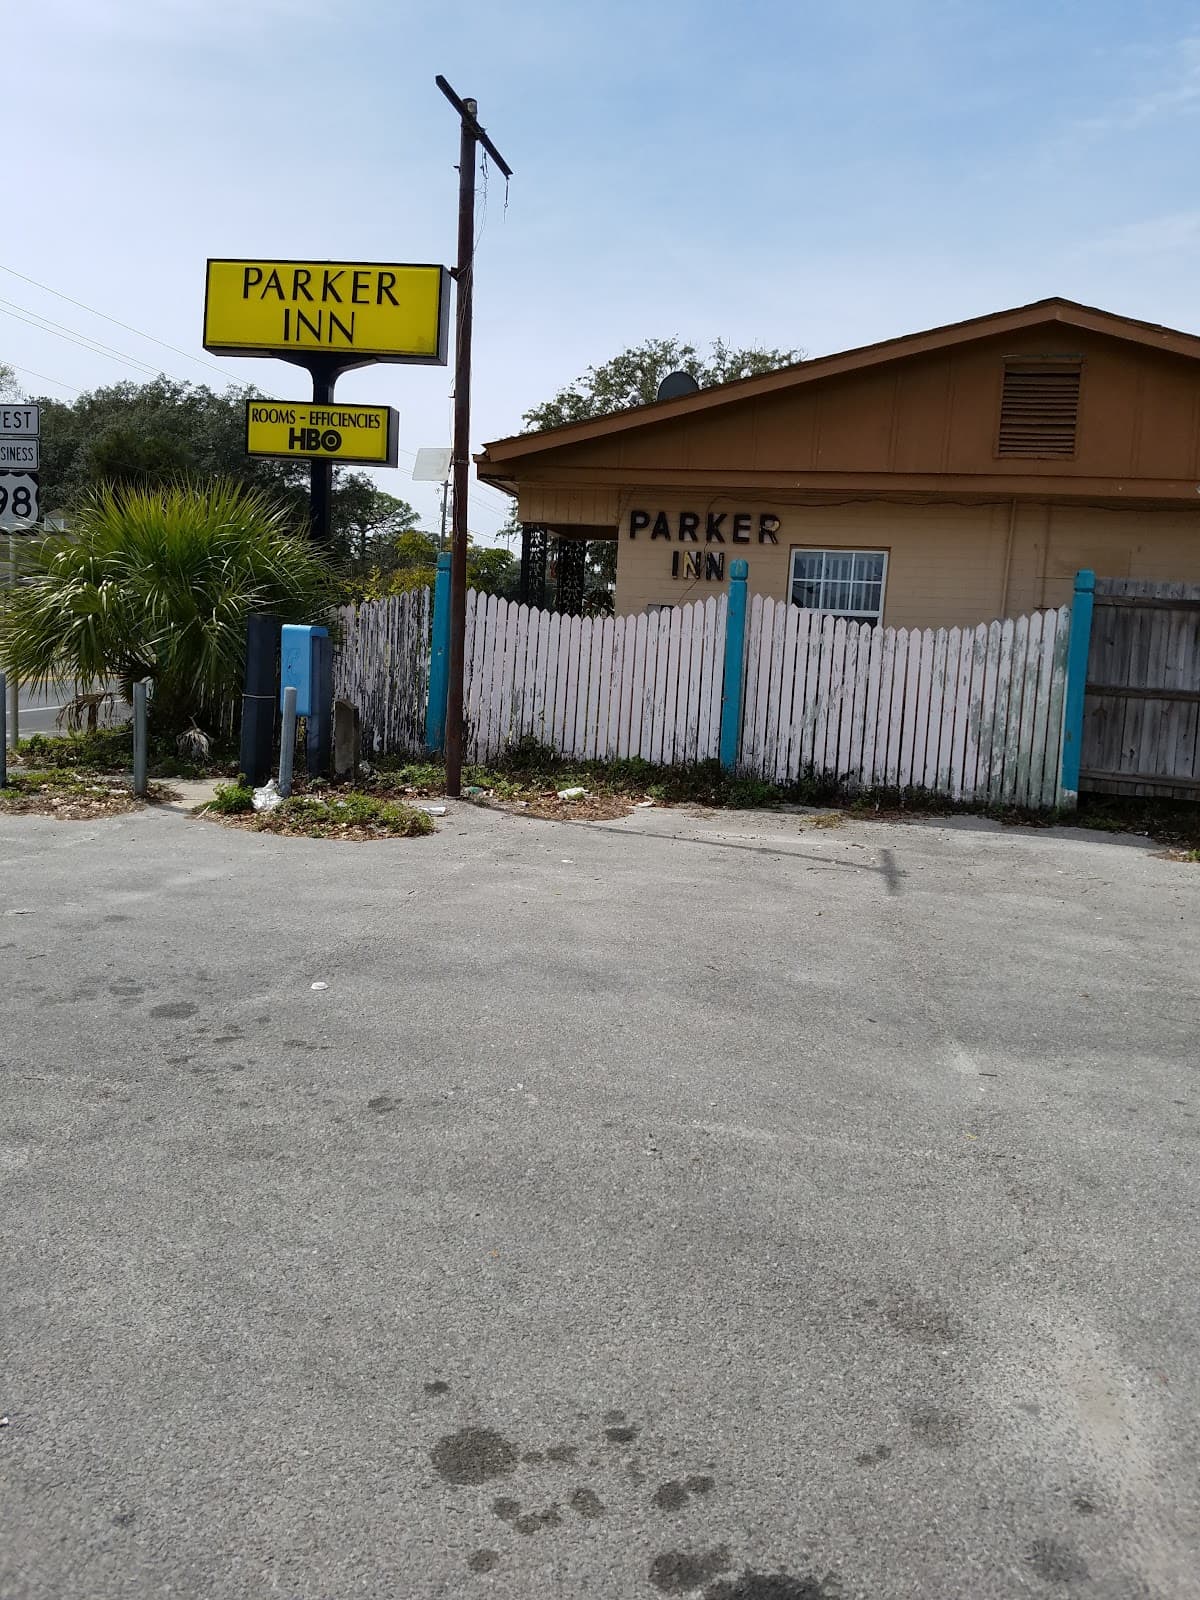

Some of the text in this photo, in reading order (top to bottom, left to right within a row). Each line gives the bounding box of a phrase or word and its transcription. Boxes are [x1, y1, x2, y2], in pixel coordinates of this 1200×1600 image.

[242, 266, 400, 306] PARKER
[283, 308, 355, 345] INN
[0, 411, 31, 428] EST
[252, 408, 296, 424] ROOMS
[309, 411, 380, 429] EFFICIENCIES
[0, 446, 34, 461] SINESS
[288, 427, 342, 452] HBO
[629, 510, 781, 545] PARKER
[671, 550, 725, 582] INN
